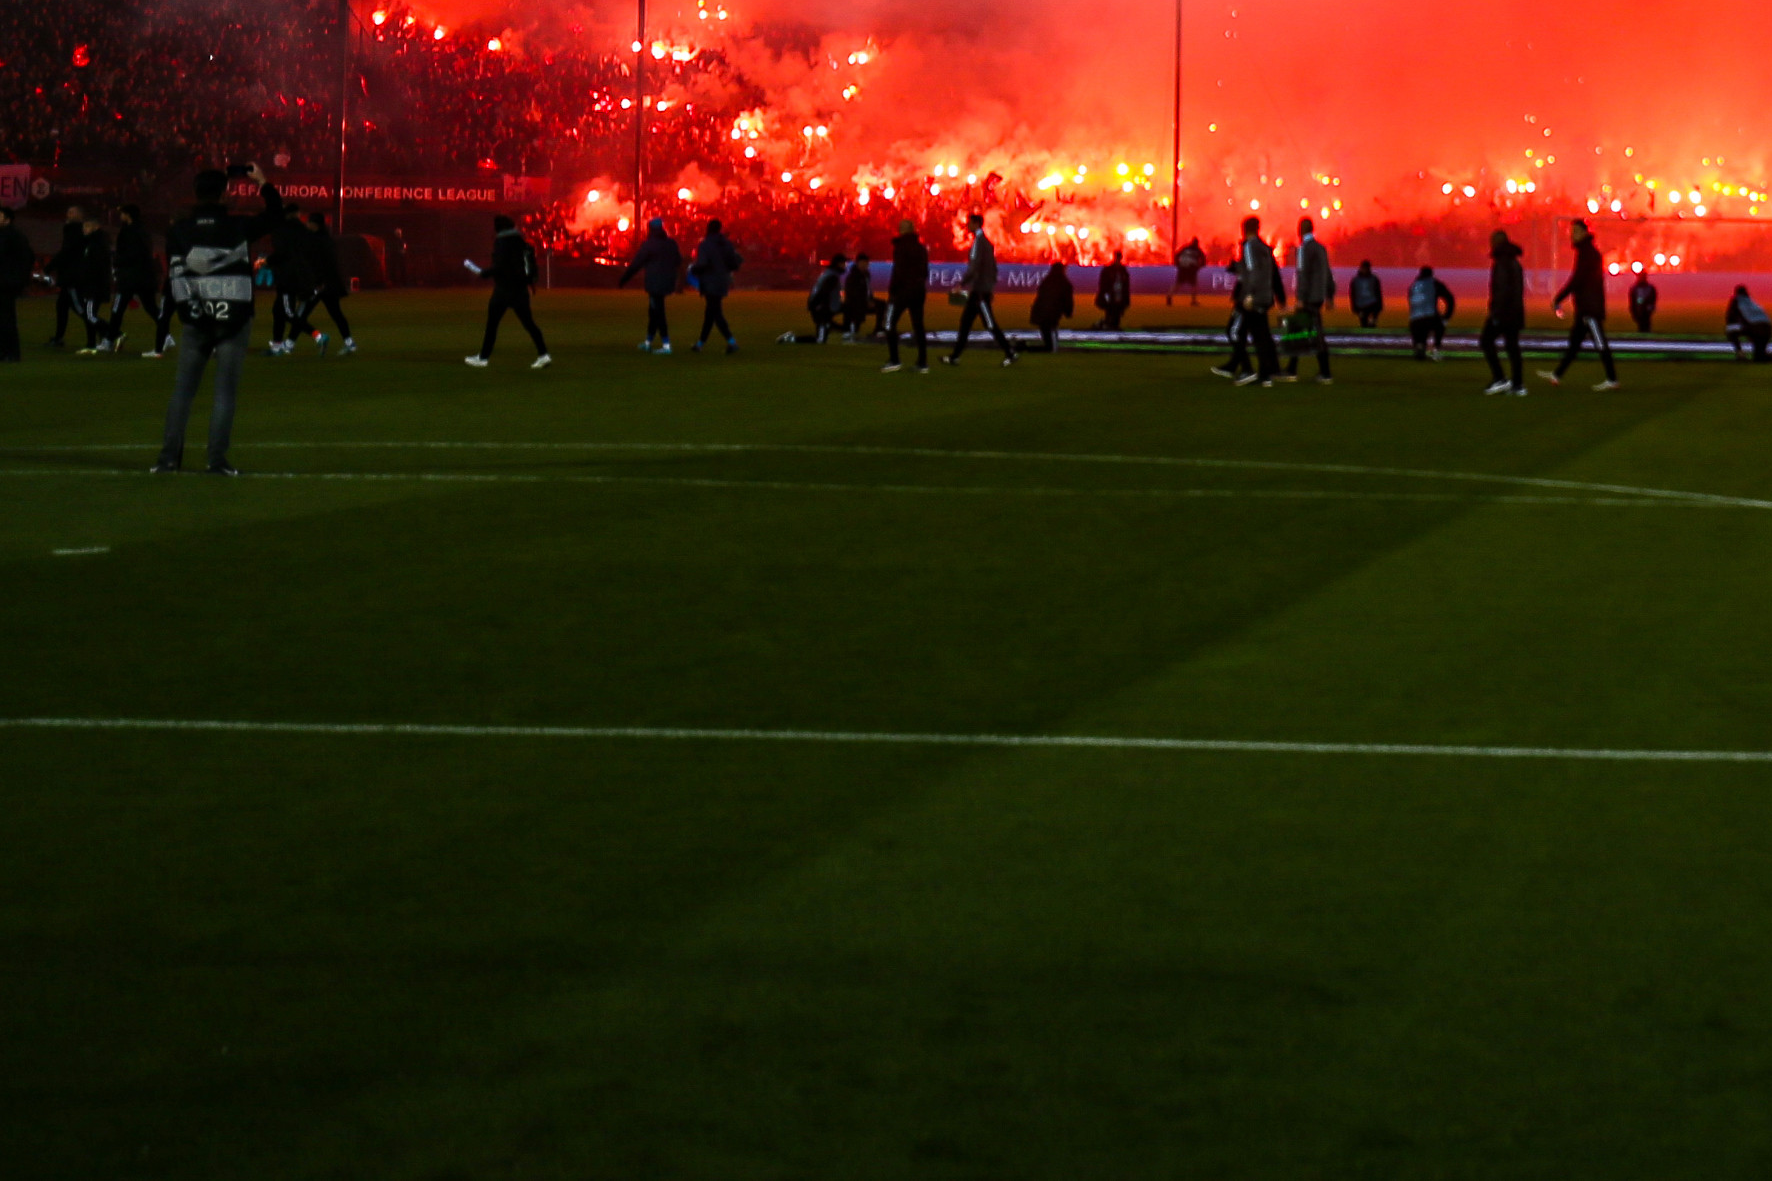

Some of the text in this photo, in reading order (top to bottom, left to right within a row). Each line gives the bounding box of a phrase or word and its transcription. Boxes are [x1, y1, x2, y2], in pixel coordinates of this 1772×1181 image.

[273, 184, 329, 198] UROPA
[332, 186, 432, 201] ONFERENCE
[437, 189, 497, 204] LEAGUE
